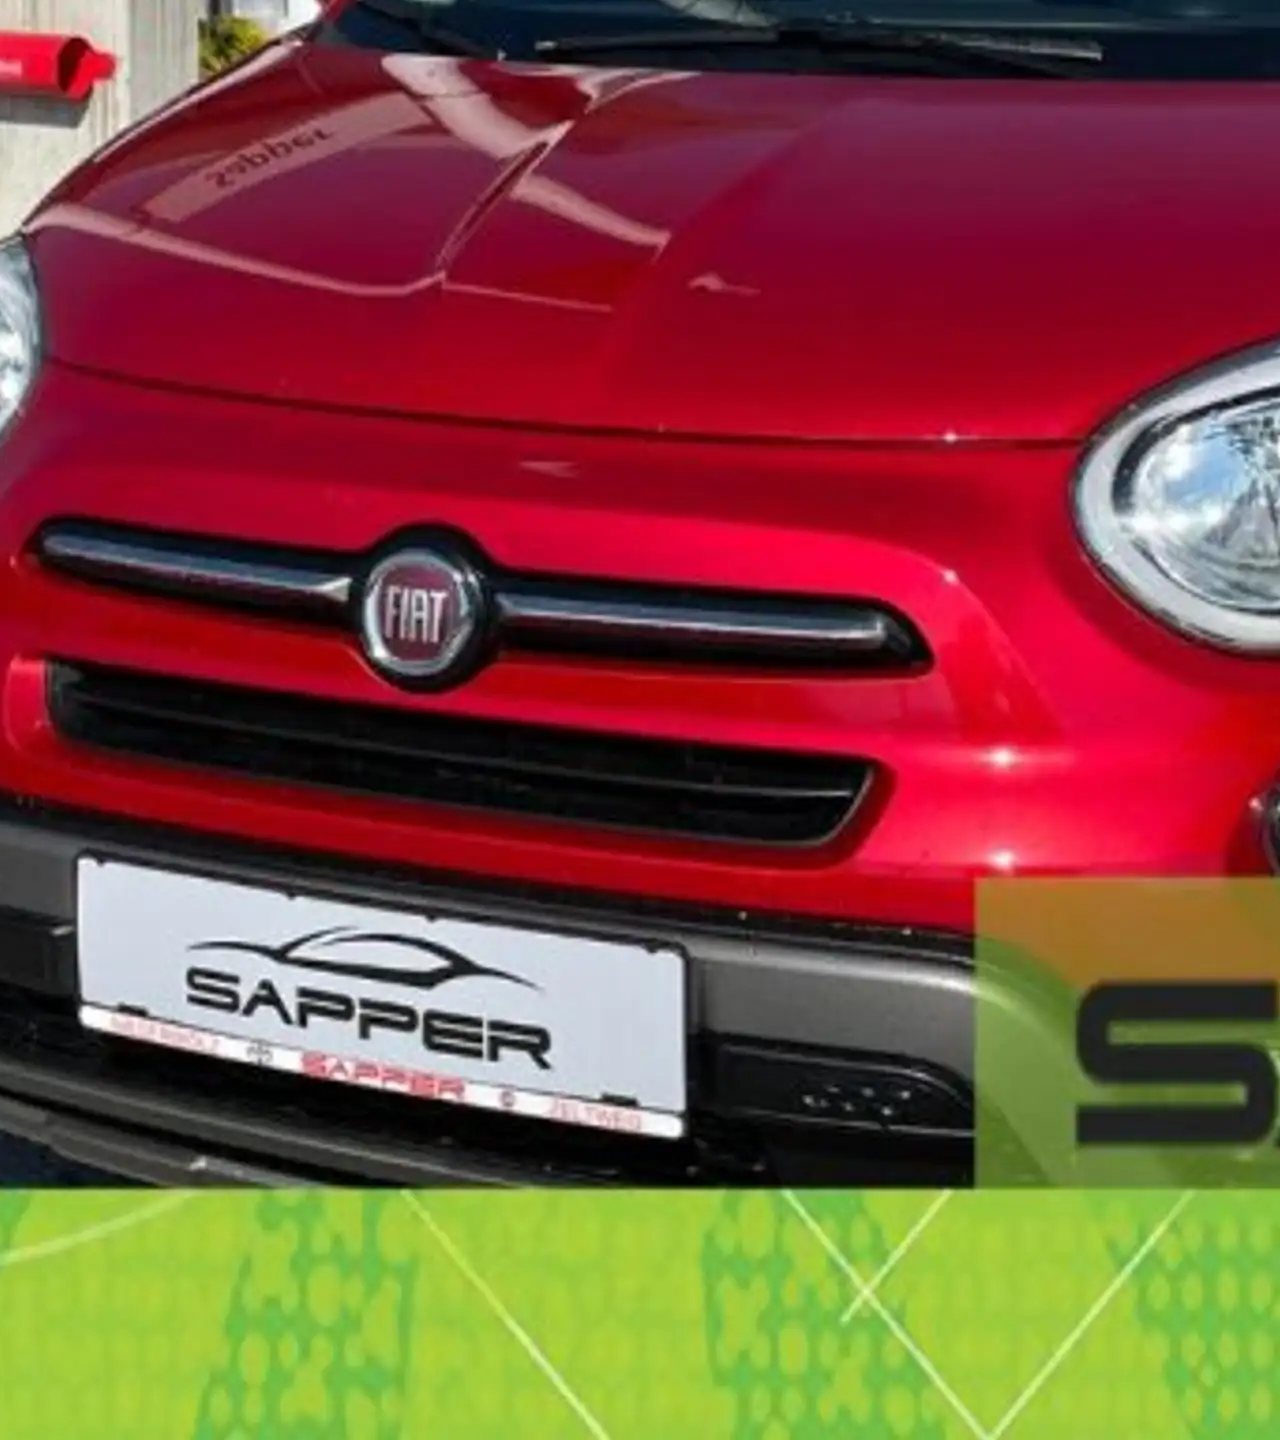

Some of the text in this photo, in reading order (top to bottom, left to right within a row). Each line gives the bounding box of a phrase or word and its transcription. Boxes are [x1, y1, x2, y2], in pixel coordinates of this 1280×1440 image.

[384, 584, 449, 644] FIAT
[185, 966, 553, 1070] SAPPER
[302, 1052, 467, 1101] SAPPER
